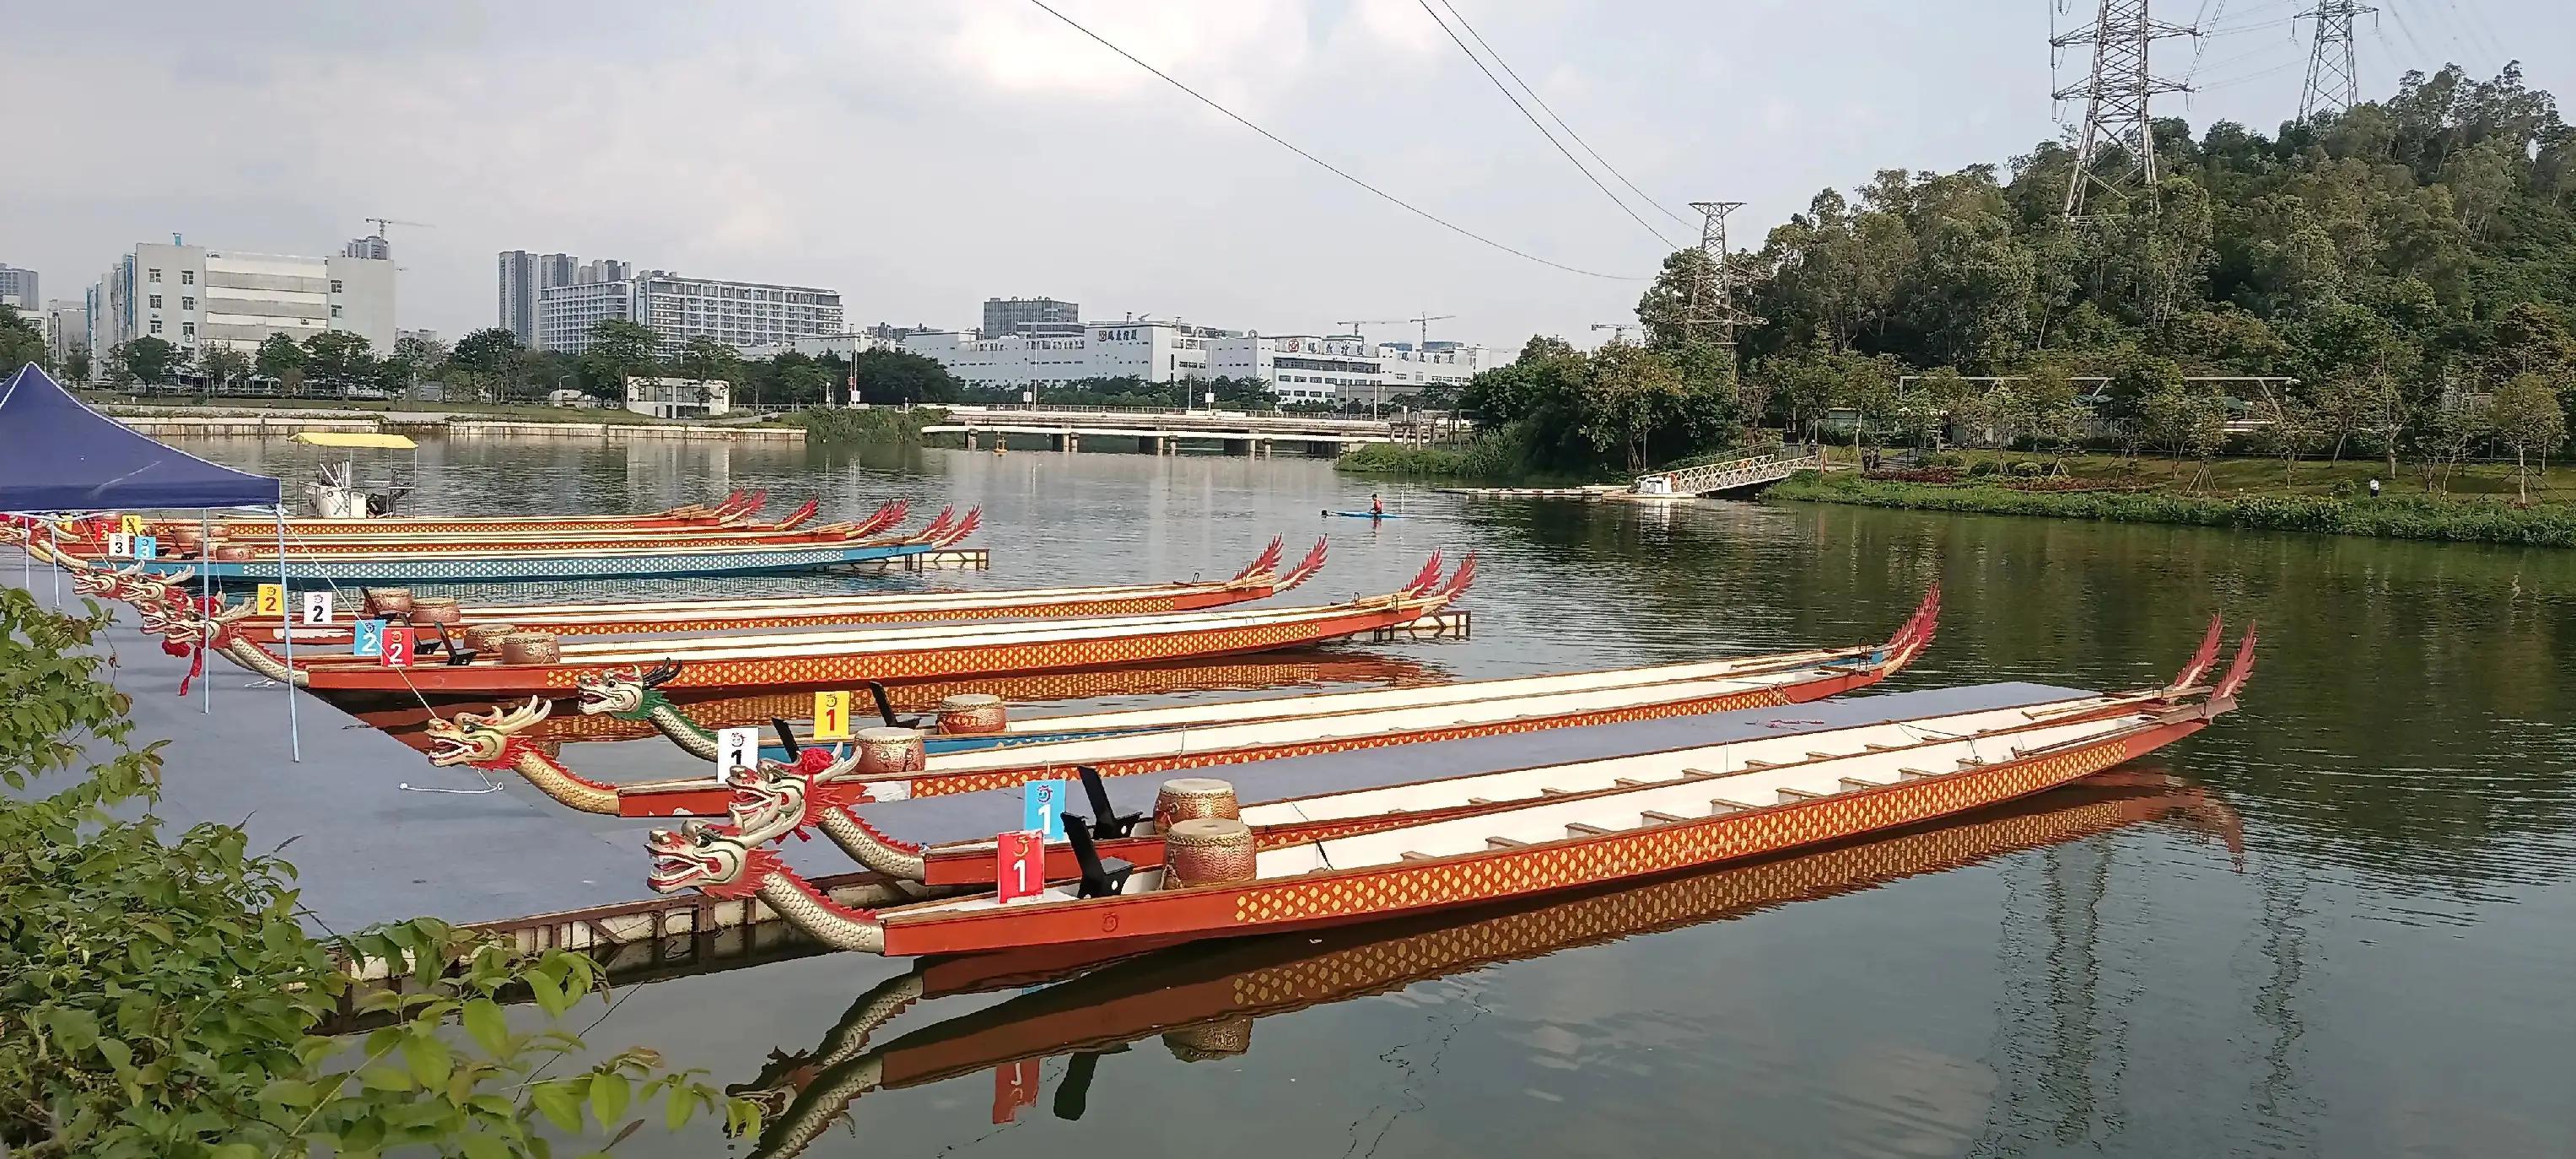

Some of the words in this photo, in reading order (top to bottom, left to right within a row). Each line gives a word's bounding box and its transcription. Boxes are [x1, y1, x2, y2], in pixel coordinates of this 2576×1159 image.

[100, 529, 109, 541] 3
[115, 542, 123, 554] 3
[140, 546, 150, 558] 3
[265, 596, 277, 612] 2
[312, 605, 324, 623] 2
[361, 632, 377, 652] 2
[389, 643, 403, 663] 2
[826, 709, 835, 731] 1
[730, 749, 742, 765] 1
[1037, 803, 1051, 835] 1
[1012, 859, 1026, 892] 1
